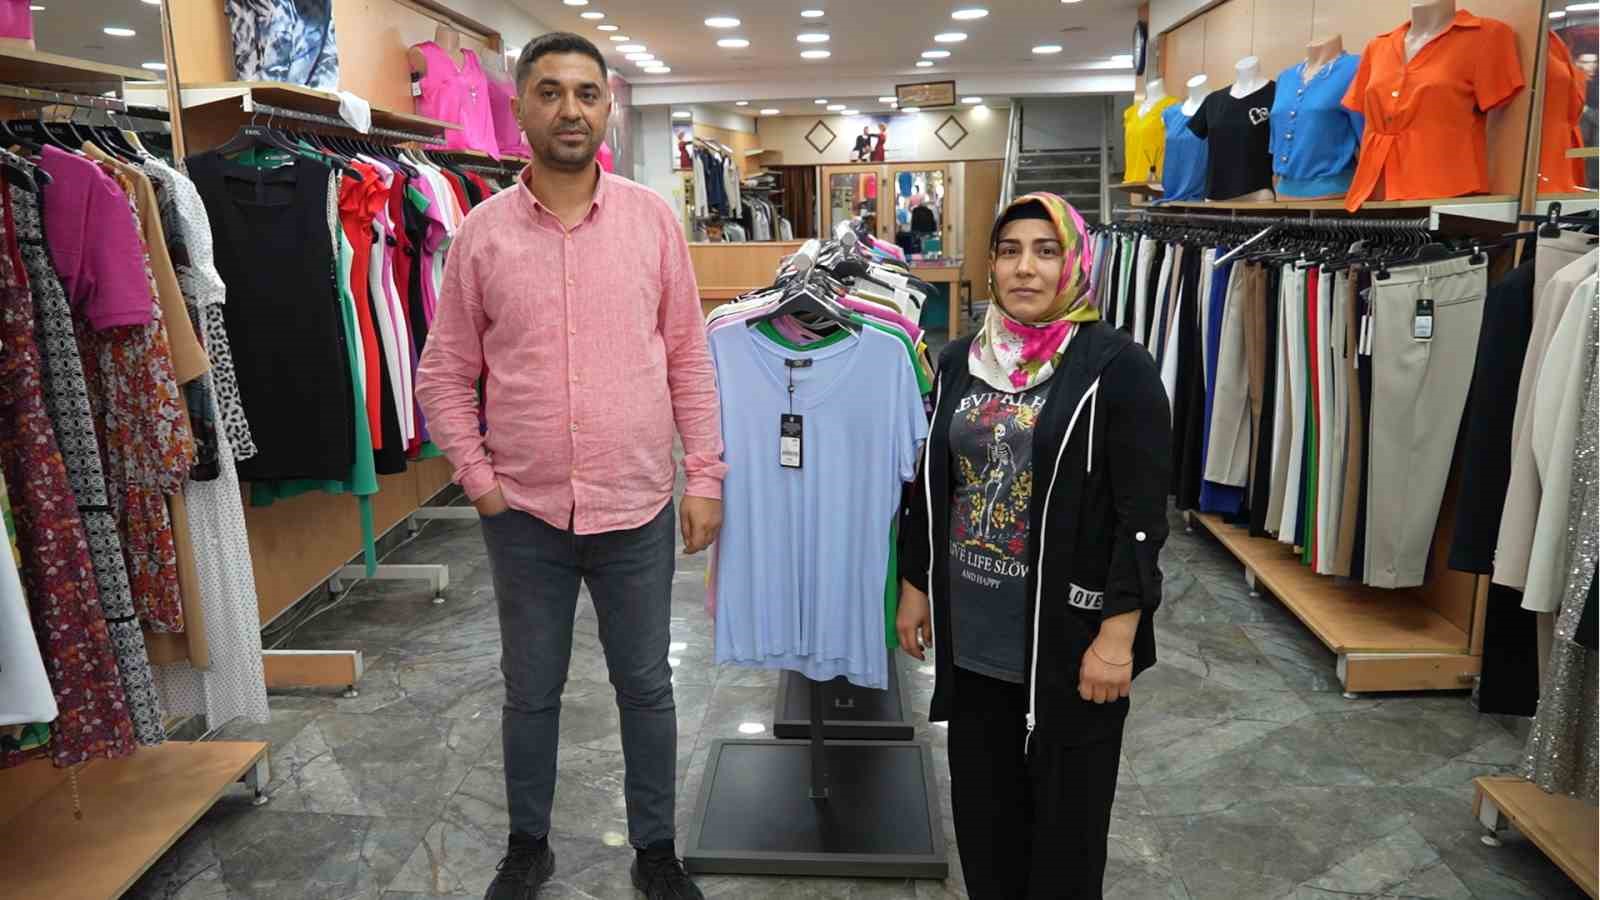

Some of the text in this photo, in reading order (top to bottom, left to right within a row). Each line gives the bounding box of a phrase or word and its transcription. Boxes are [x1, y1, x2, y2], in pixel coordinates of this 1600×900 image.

[968, 551, 992, 572] LIFE
[962, 568, 1001, 589] AND HAPPY
